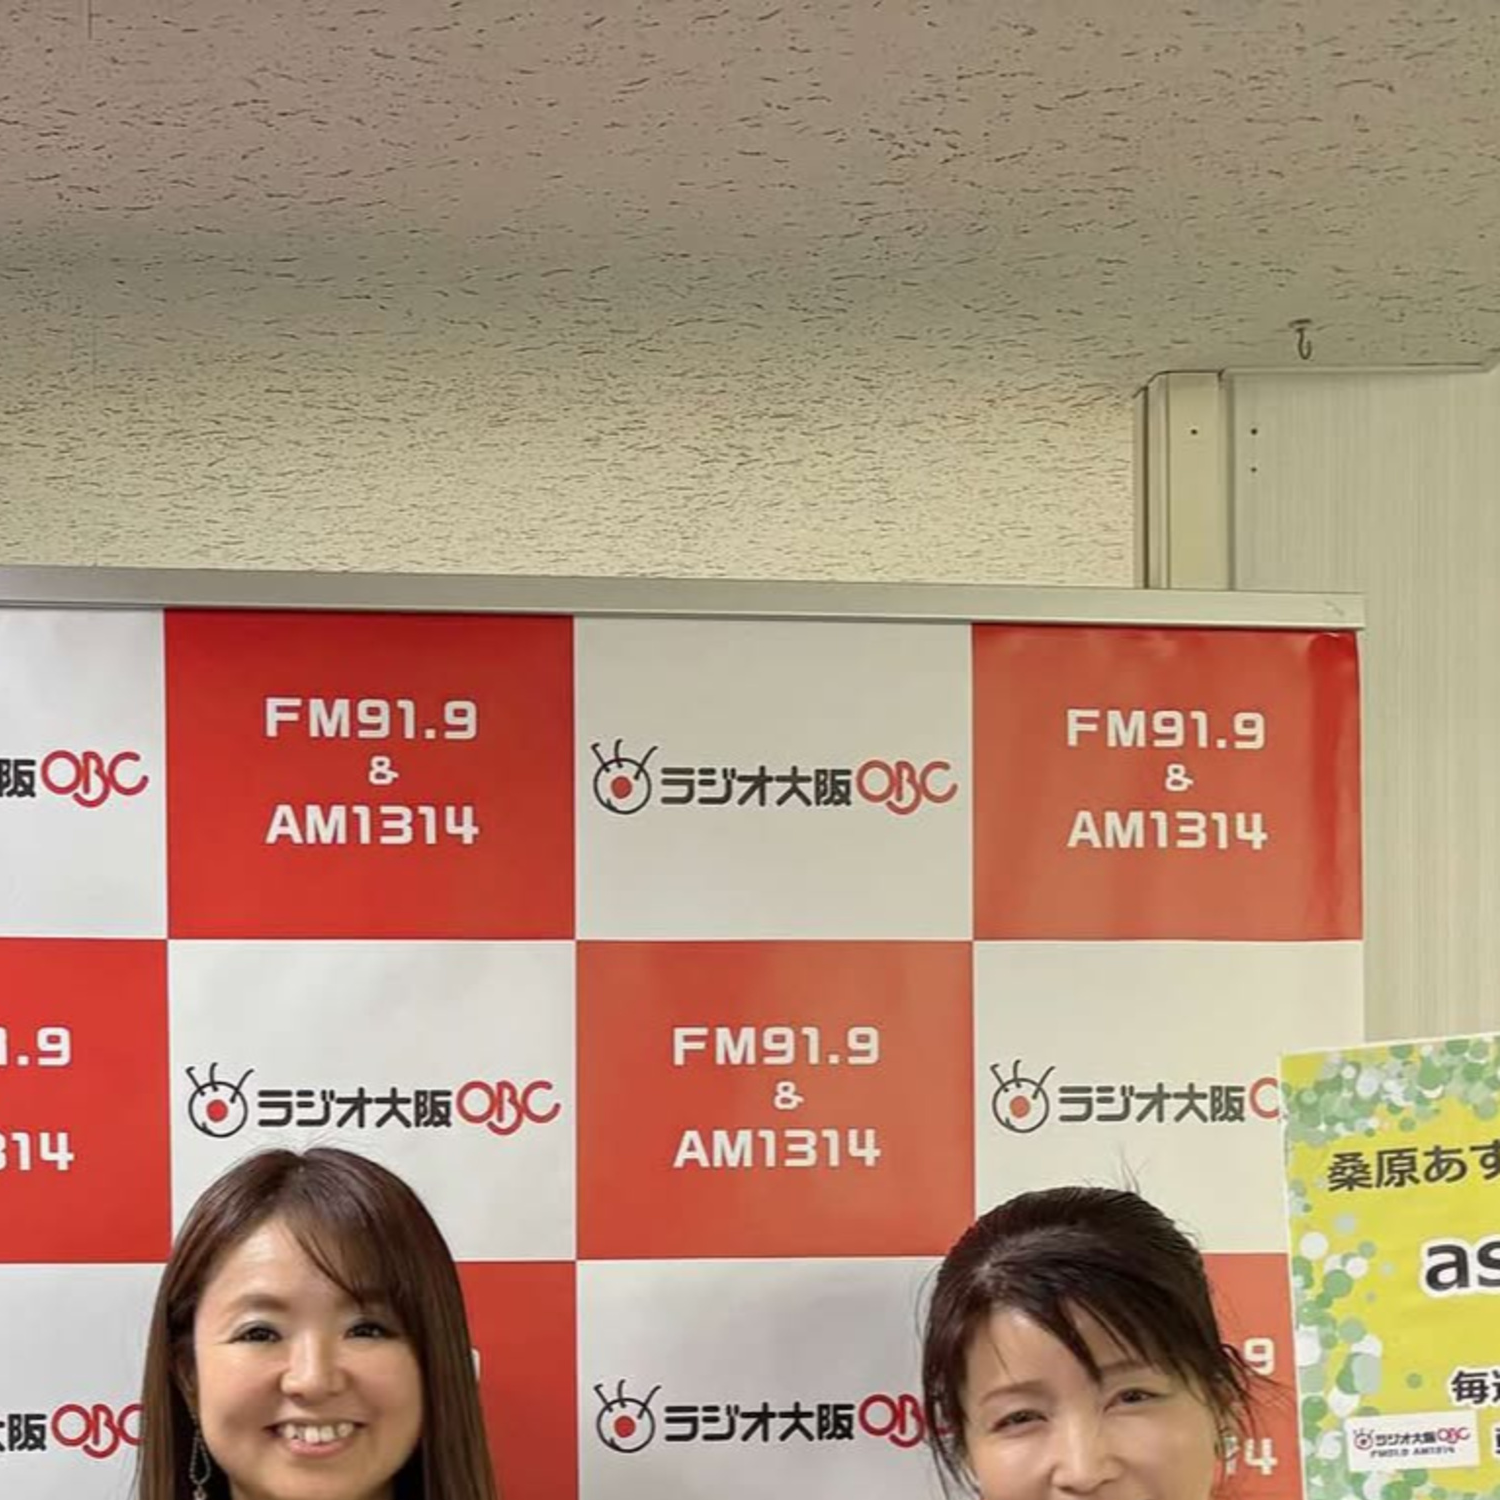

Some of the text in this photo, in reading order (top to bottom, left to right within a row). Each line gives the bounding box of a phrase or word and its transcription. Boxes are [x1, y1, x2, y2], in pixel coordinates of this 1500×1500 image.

[265, 698, 478, 741] FM91.9
[1066, 709, 1266, 750] FM91.9
[368, 755, 399, 785] &
[1165, 763, 1193, 791] &
[265, 804, 479, 845] AM1314
[1067, 811, 1267, 850] AM1314
[673, 1027, 881, 1066] FM91.9
[774, 1082, 803, 1111] &
[673, 1129, 882, 1169] AM1314
[664, 1394, 928, 1448] ラジオ大阪OB
